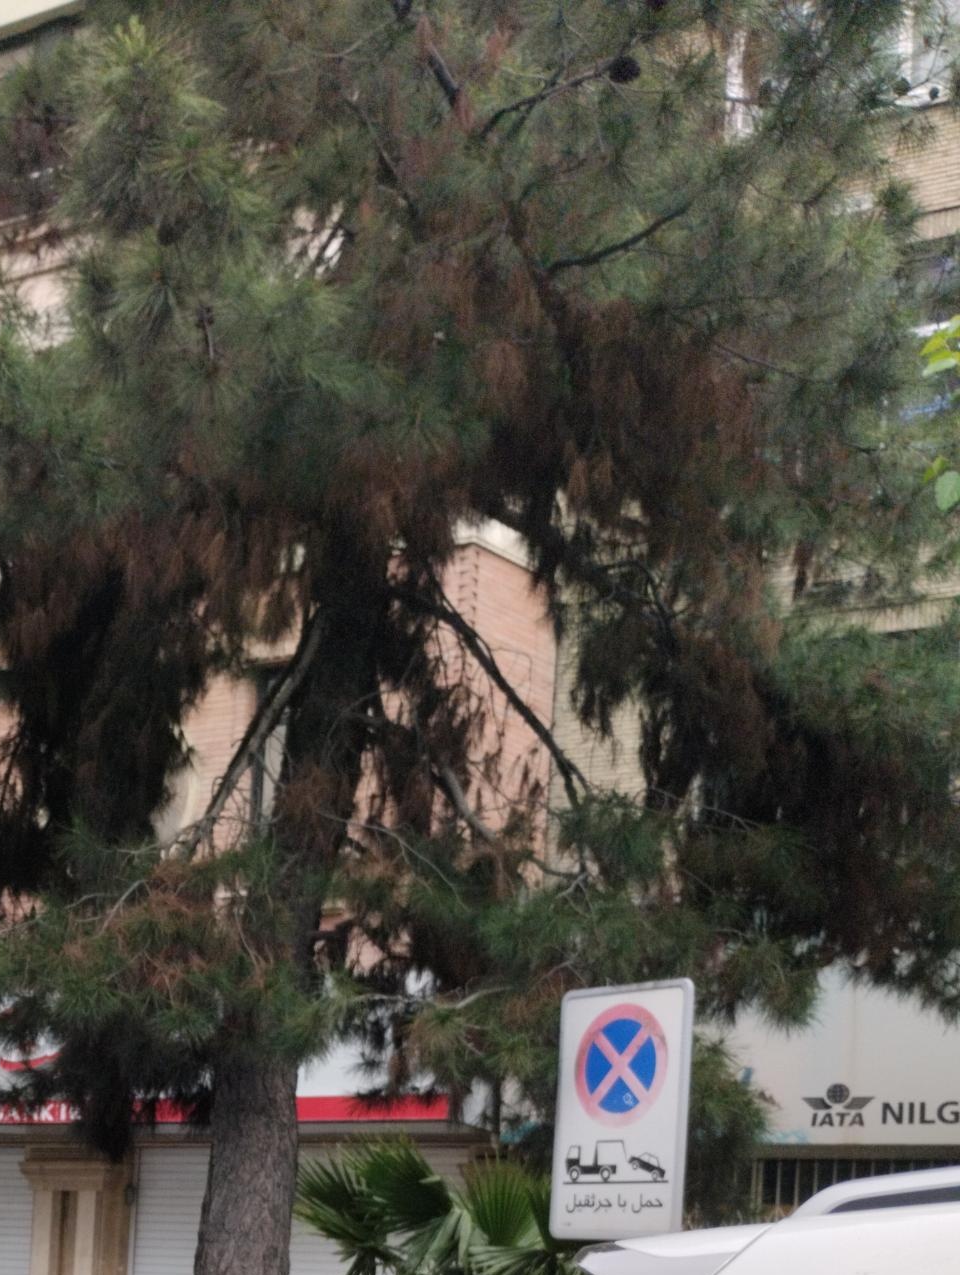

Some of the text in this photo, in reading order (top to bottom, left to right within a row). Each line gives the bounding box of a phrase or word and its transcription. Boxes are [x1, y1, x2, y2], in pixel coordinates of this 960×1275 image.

[811, 1112, 865, 1127] IATA
[881, 1101, 960, 1125] NILG
[566, 1192, 663, 1213] حمل با جرثقیل
